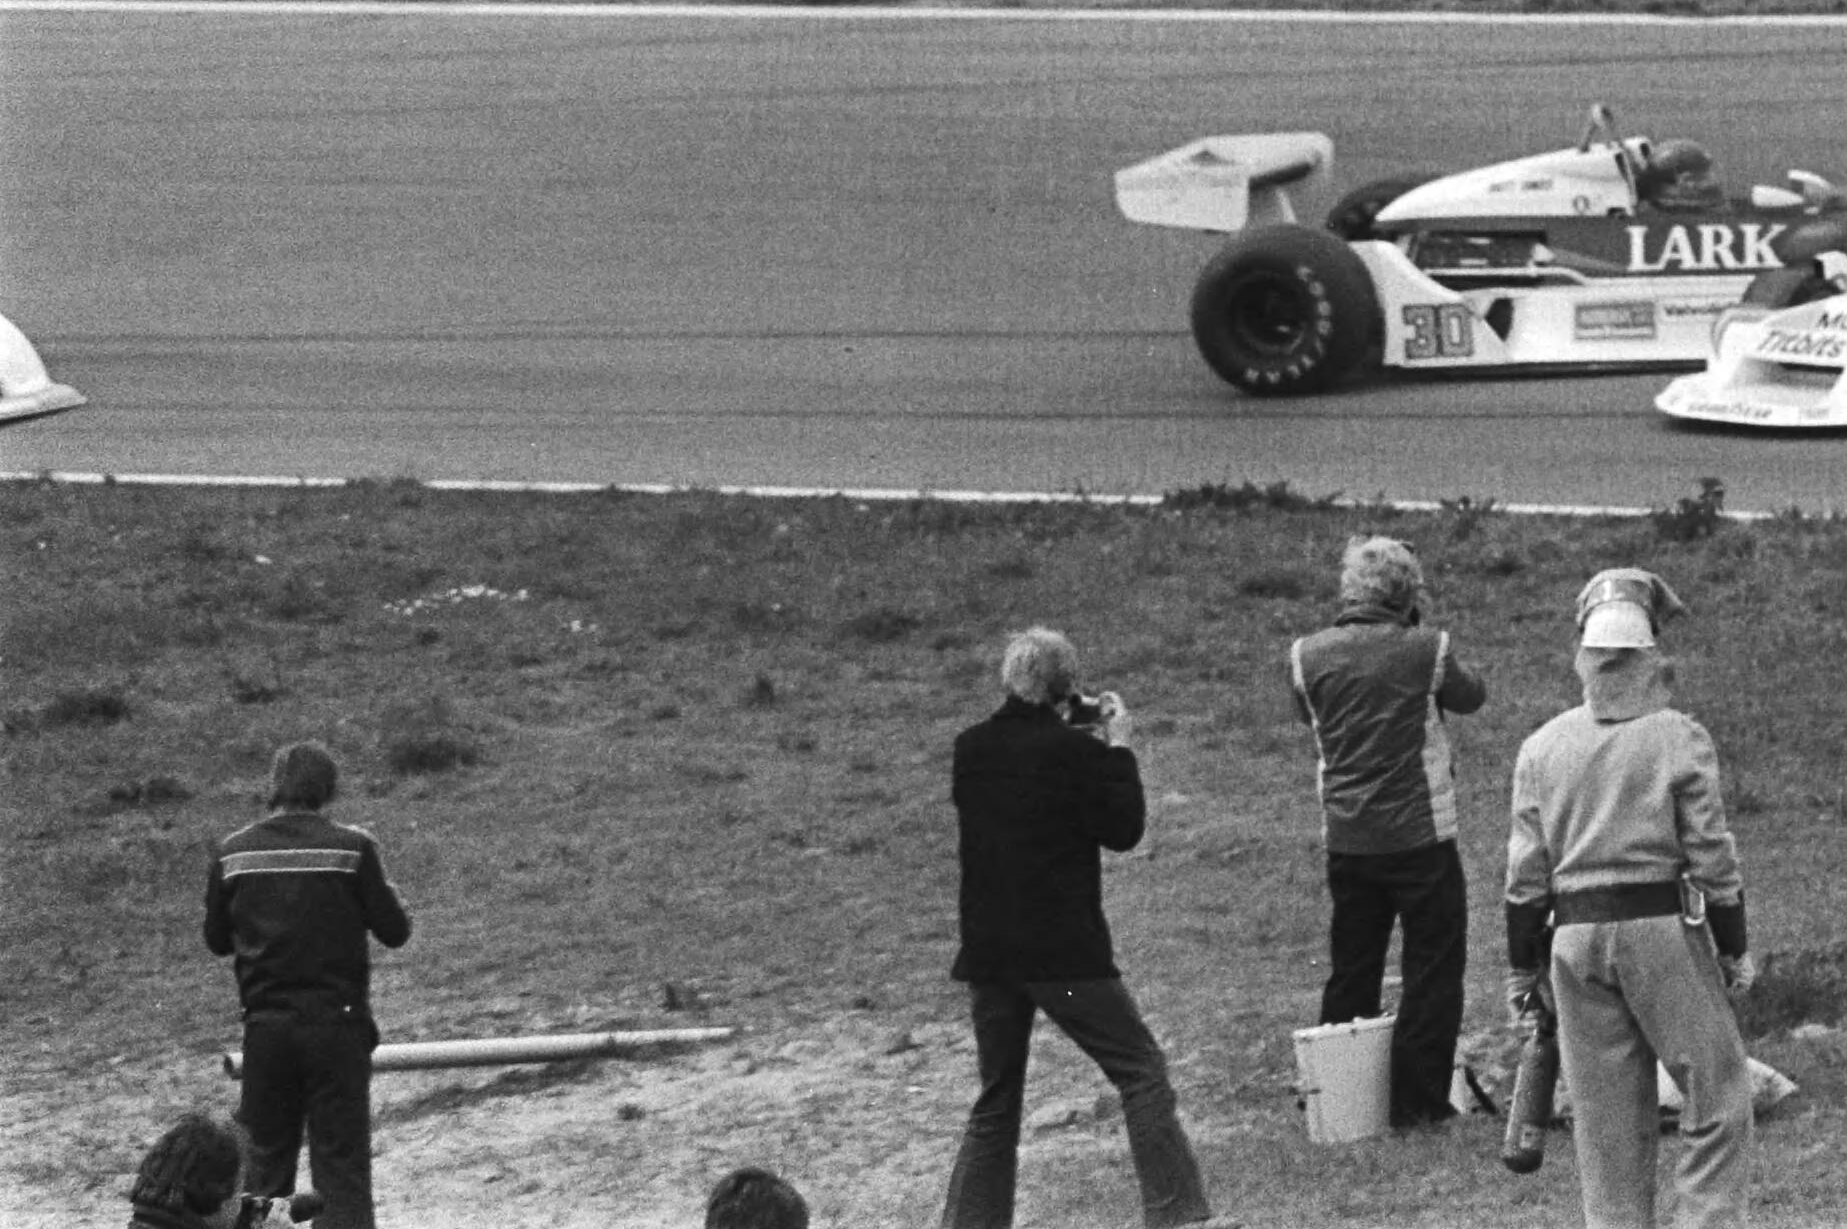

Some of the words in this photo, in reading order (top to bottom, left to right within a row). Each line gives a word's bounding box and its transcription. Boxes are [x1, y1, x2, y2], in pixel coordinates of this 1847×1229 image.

[1625, 223, 1788, 272] LARK
[1402, 303, 1475, 360] 30
[1756, 329, 1847, 358] Titbits
